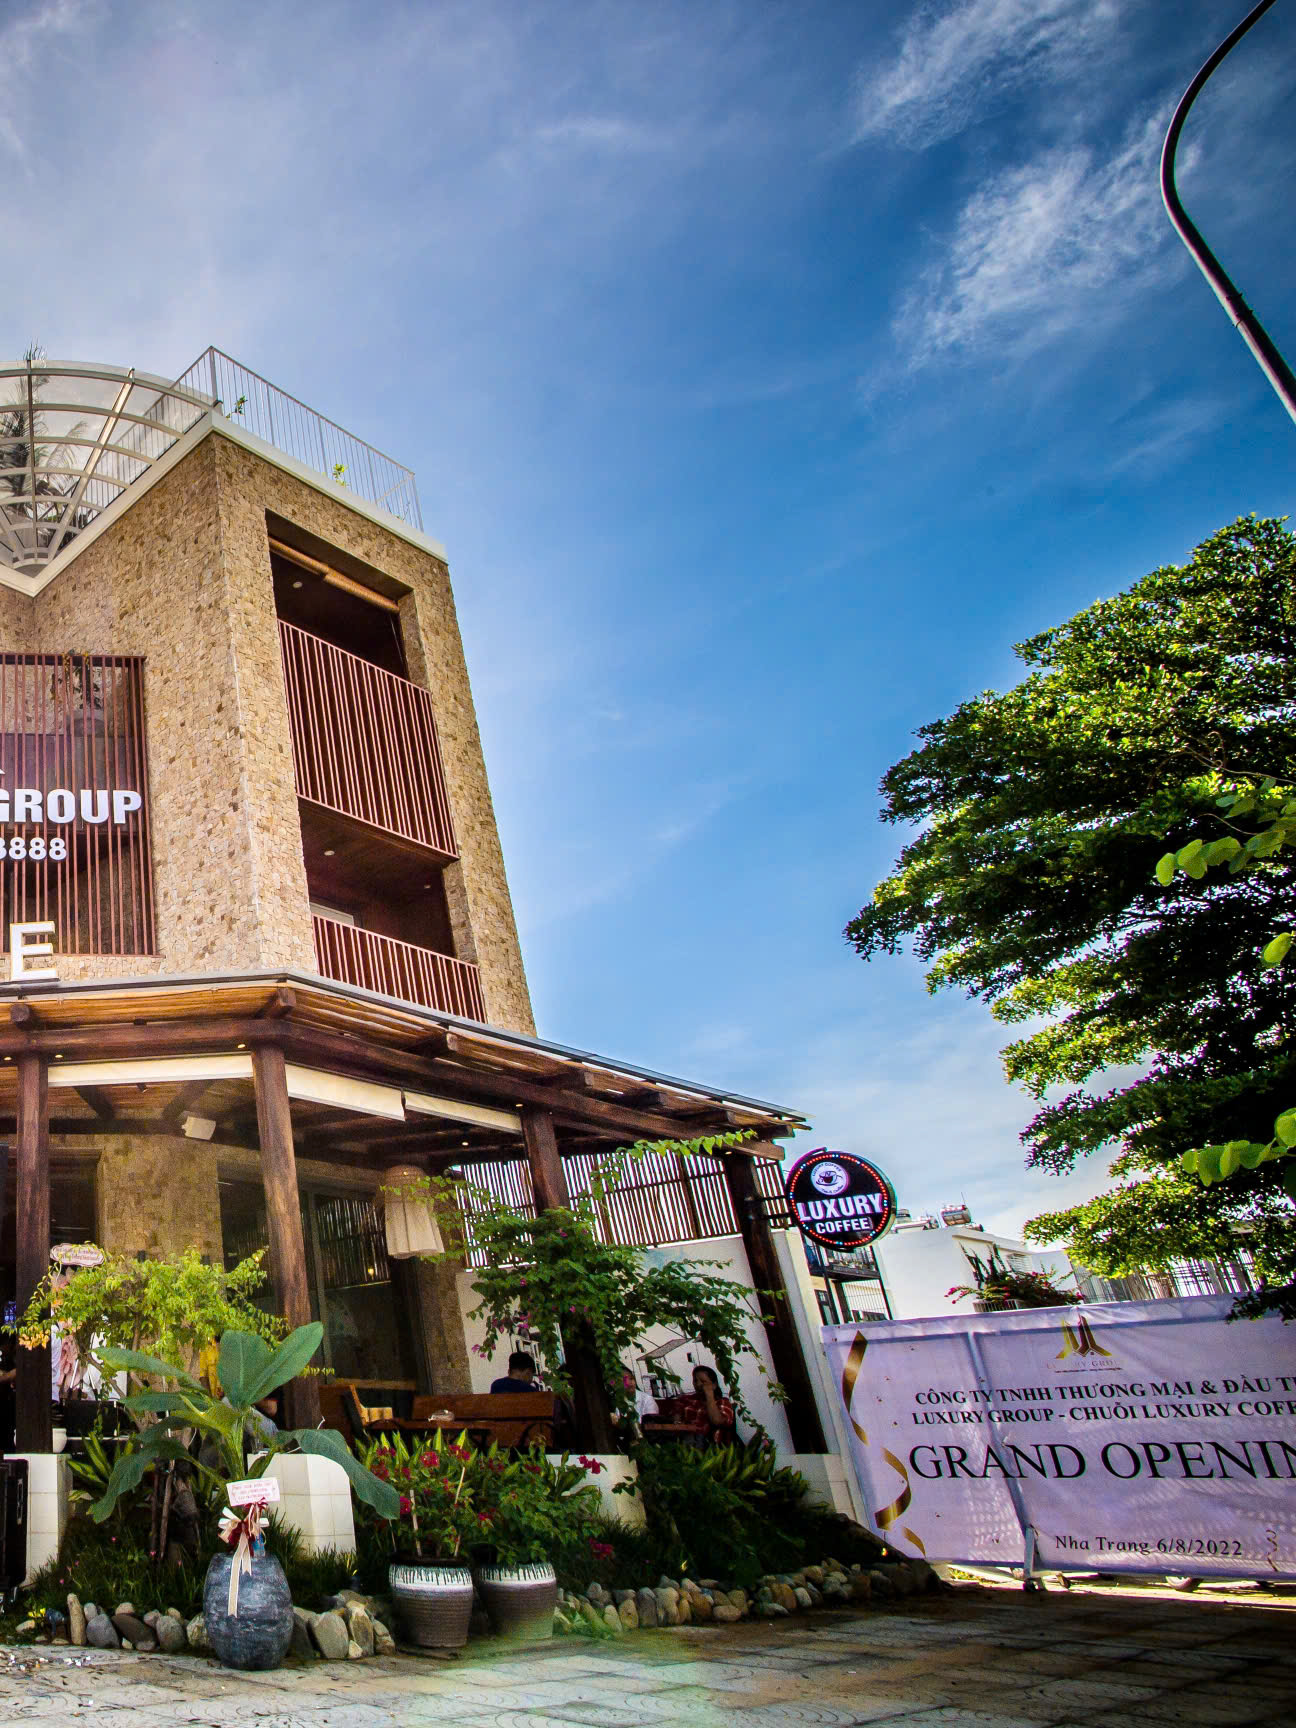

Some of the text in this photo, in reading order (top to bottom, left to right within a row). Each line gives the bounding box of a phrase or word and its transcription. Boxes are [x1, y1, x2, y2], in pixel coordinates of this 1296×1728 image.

[796, 1193, 883, 1221] LUXURY
[815, 1217, 870, 1234] COFFEE
[915, 1388, 966, 1405] CÔNG
[969, 1389, 992, 1402] TY
[996, 1388, 1053, 1402] TNHH
[1055, 1383, 1146, 1399] THƯƠNG
[1149, 1381, 1195, 1398] MẠI
[1200, 1379, 1217, 1394] &
[1275, 1376, 1296, 1391] T
[912, 1410, 983, 1425] LUXURY
[987, 1408, 1054, 1423] GROUP
[1142, 1402, 1231, 1419] LUXURY
[909, 1444, 1086, 1479] GRAND
[1055, 1536, 1242, 1555] Nha Trang 6/8/2022
